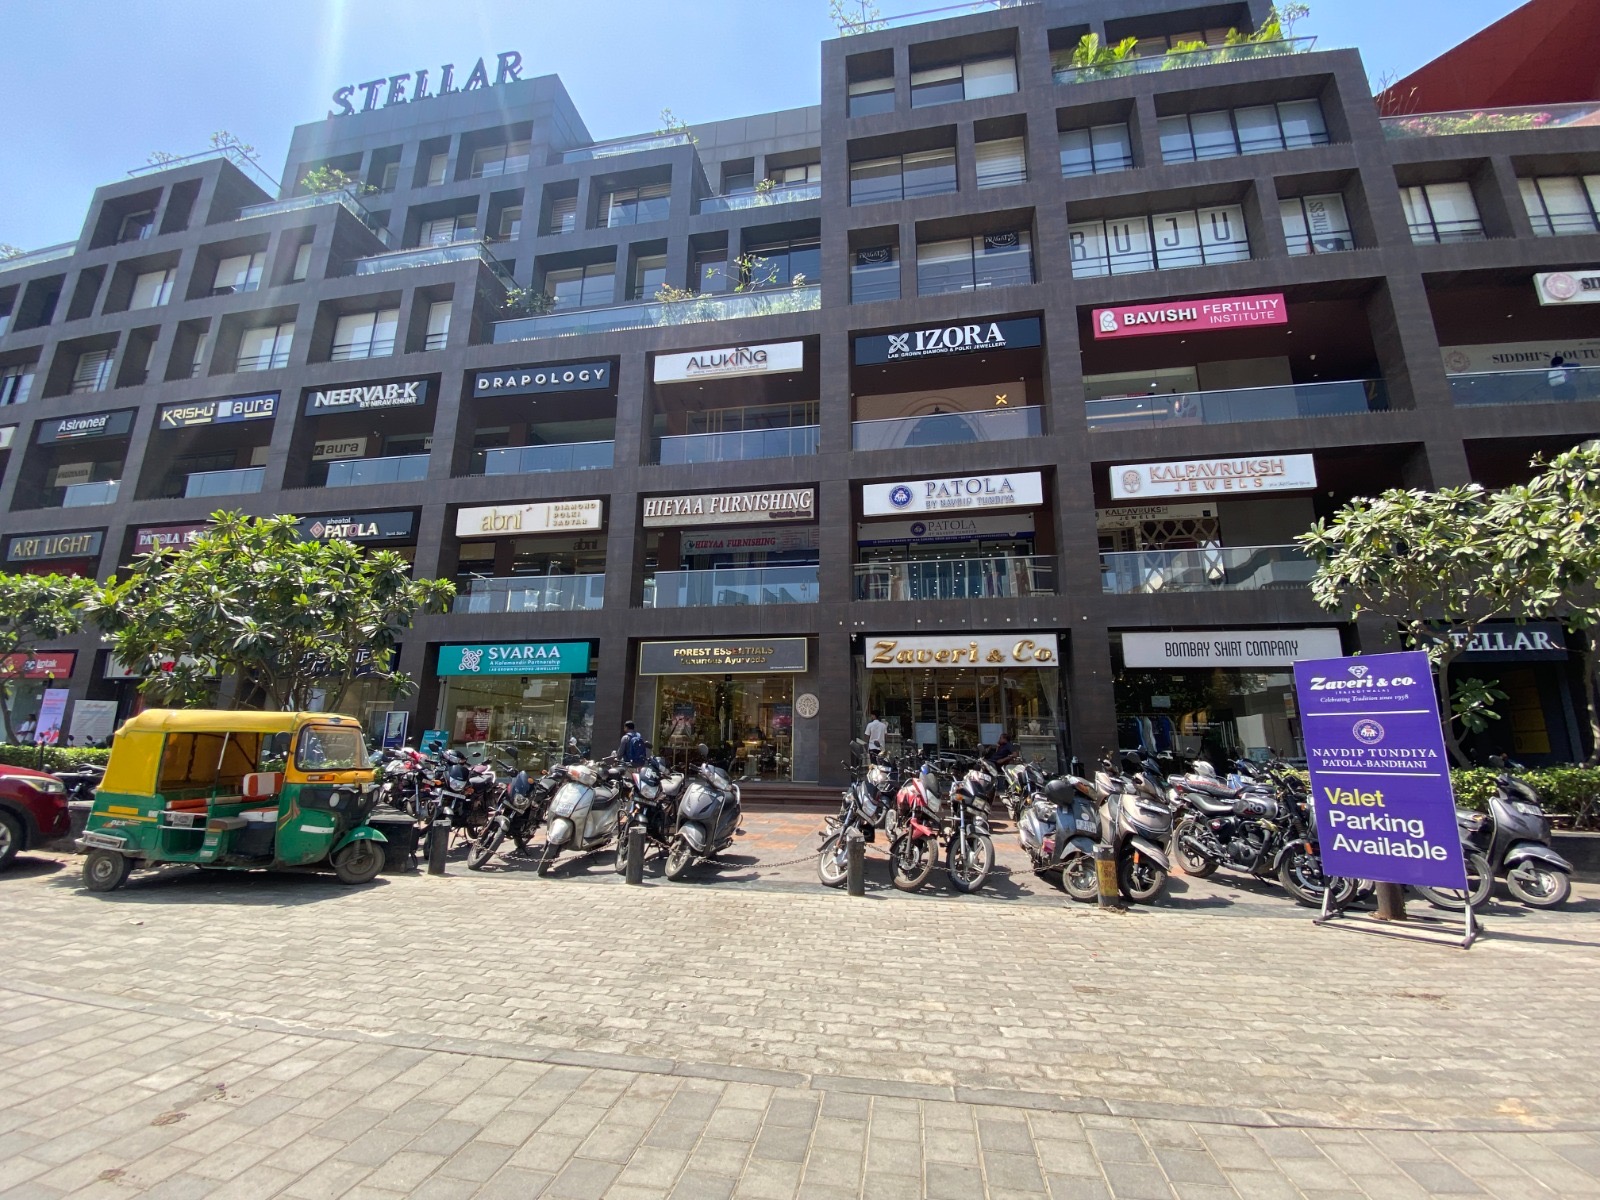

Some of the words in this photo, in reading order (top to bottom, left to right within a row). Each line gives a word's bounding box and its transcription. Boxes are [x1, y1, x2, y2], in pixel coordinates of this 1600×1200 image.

[328, 50, 523, 119] STELLAR
[1203, 298, 1279, 315] FERTILITY
[1123, 307, 1198, 326] BAVISHI
[1210, 310, 1275, 324] INSTITUTE
[915, 322, 1006, 351] IZORA
[900, 350, 921, 358] GROWN
[922, 347, 949, 355] DIAMOND
[973, 341, 1007, 350] JEWELLERY
[1492, 351, 1550, 364] SIDDHI'S
[1554, 349, 1600, 361] COUTU
[686, 350, 767, 370] ALUKING
[478, 368, 605, 390] DRAPOLOGY
[314, 381, 420, 408] NEERVAB-K
[359, 400, 370, 408] BY
[370, 398, 391, 407] NIRAV
[392, 396, 417, 405] KHUNT
[233, 398, 274, 414] aura
[325, 443, 359, 454] aura
[1150, 459, 1285, 480] KALPAVRUKSH
[925, 478, 1014, 499] PATOLA
[1174, 478, 1263, 492] JEWELS
[644, 497, 704, 517] HIEYAA
[709, 491, 812, 513] FURNISHING
[925, 500, 937, 509] BY
[1105, 506, 1169, 516] KALPAVRUKSH
[481, 509, 522, 531] abni
[928, 520, 977, 531] PATOLA
[324, 523, 380, 538] PATOLA
[14, 539, 42, 557] ART
[45, 535, 92, 554] LIGHT
[695, 540, 724, 549] HIEYAA
[726, 537, 776, 547] FURNISHING
[488, 646, 561, 660] SVARAA
[674, 648, 712, 657] FOREST
[713, 646, 774, 656] ESSENTIALS
[871, 641, 979, 664] Zaveri
[986, 648, 1007, 663] &
[1012, 639, 1057, 663] Co.
[1165, 642, 1210, 657] BOMBAY
[1214, 641, 1242, 656] SHIRT
[1246, 640, 1299, 656] COMPANY
[1310, 675, 1374, 691] Zaveri
[1376, 678, 1388, 687] &
[1312, 748, 1365, 757] NAVDIP
[1368, 749, 1438, 758] TUNDIYA
[1322, 759, 1427, 769] PATOLA-BANDHANI
[1324, 787, 1386, 808] Valet
[1329, 810, 1425, 839] Parking
[1332, 833, 1448, 861] Available
